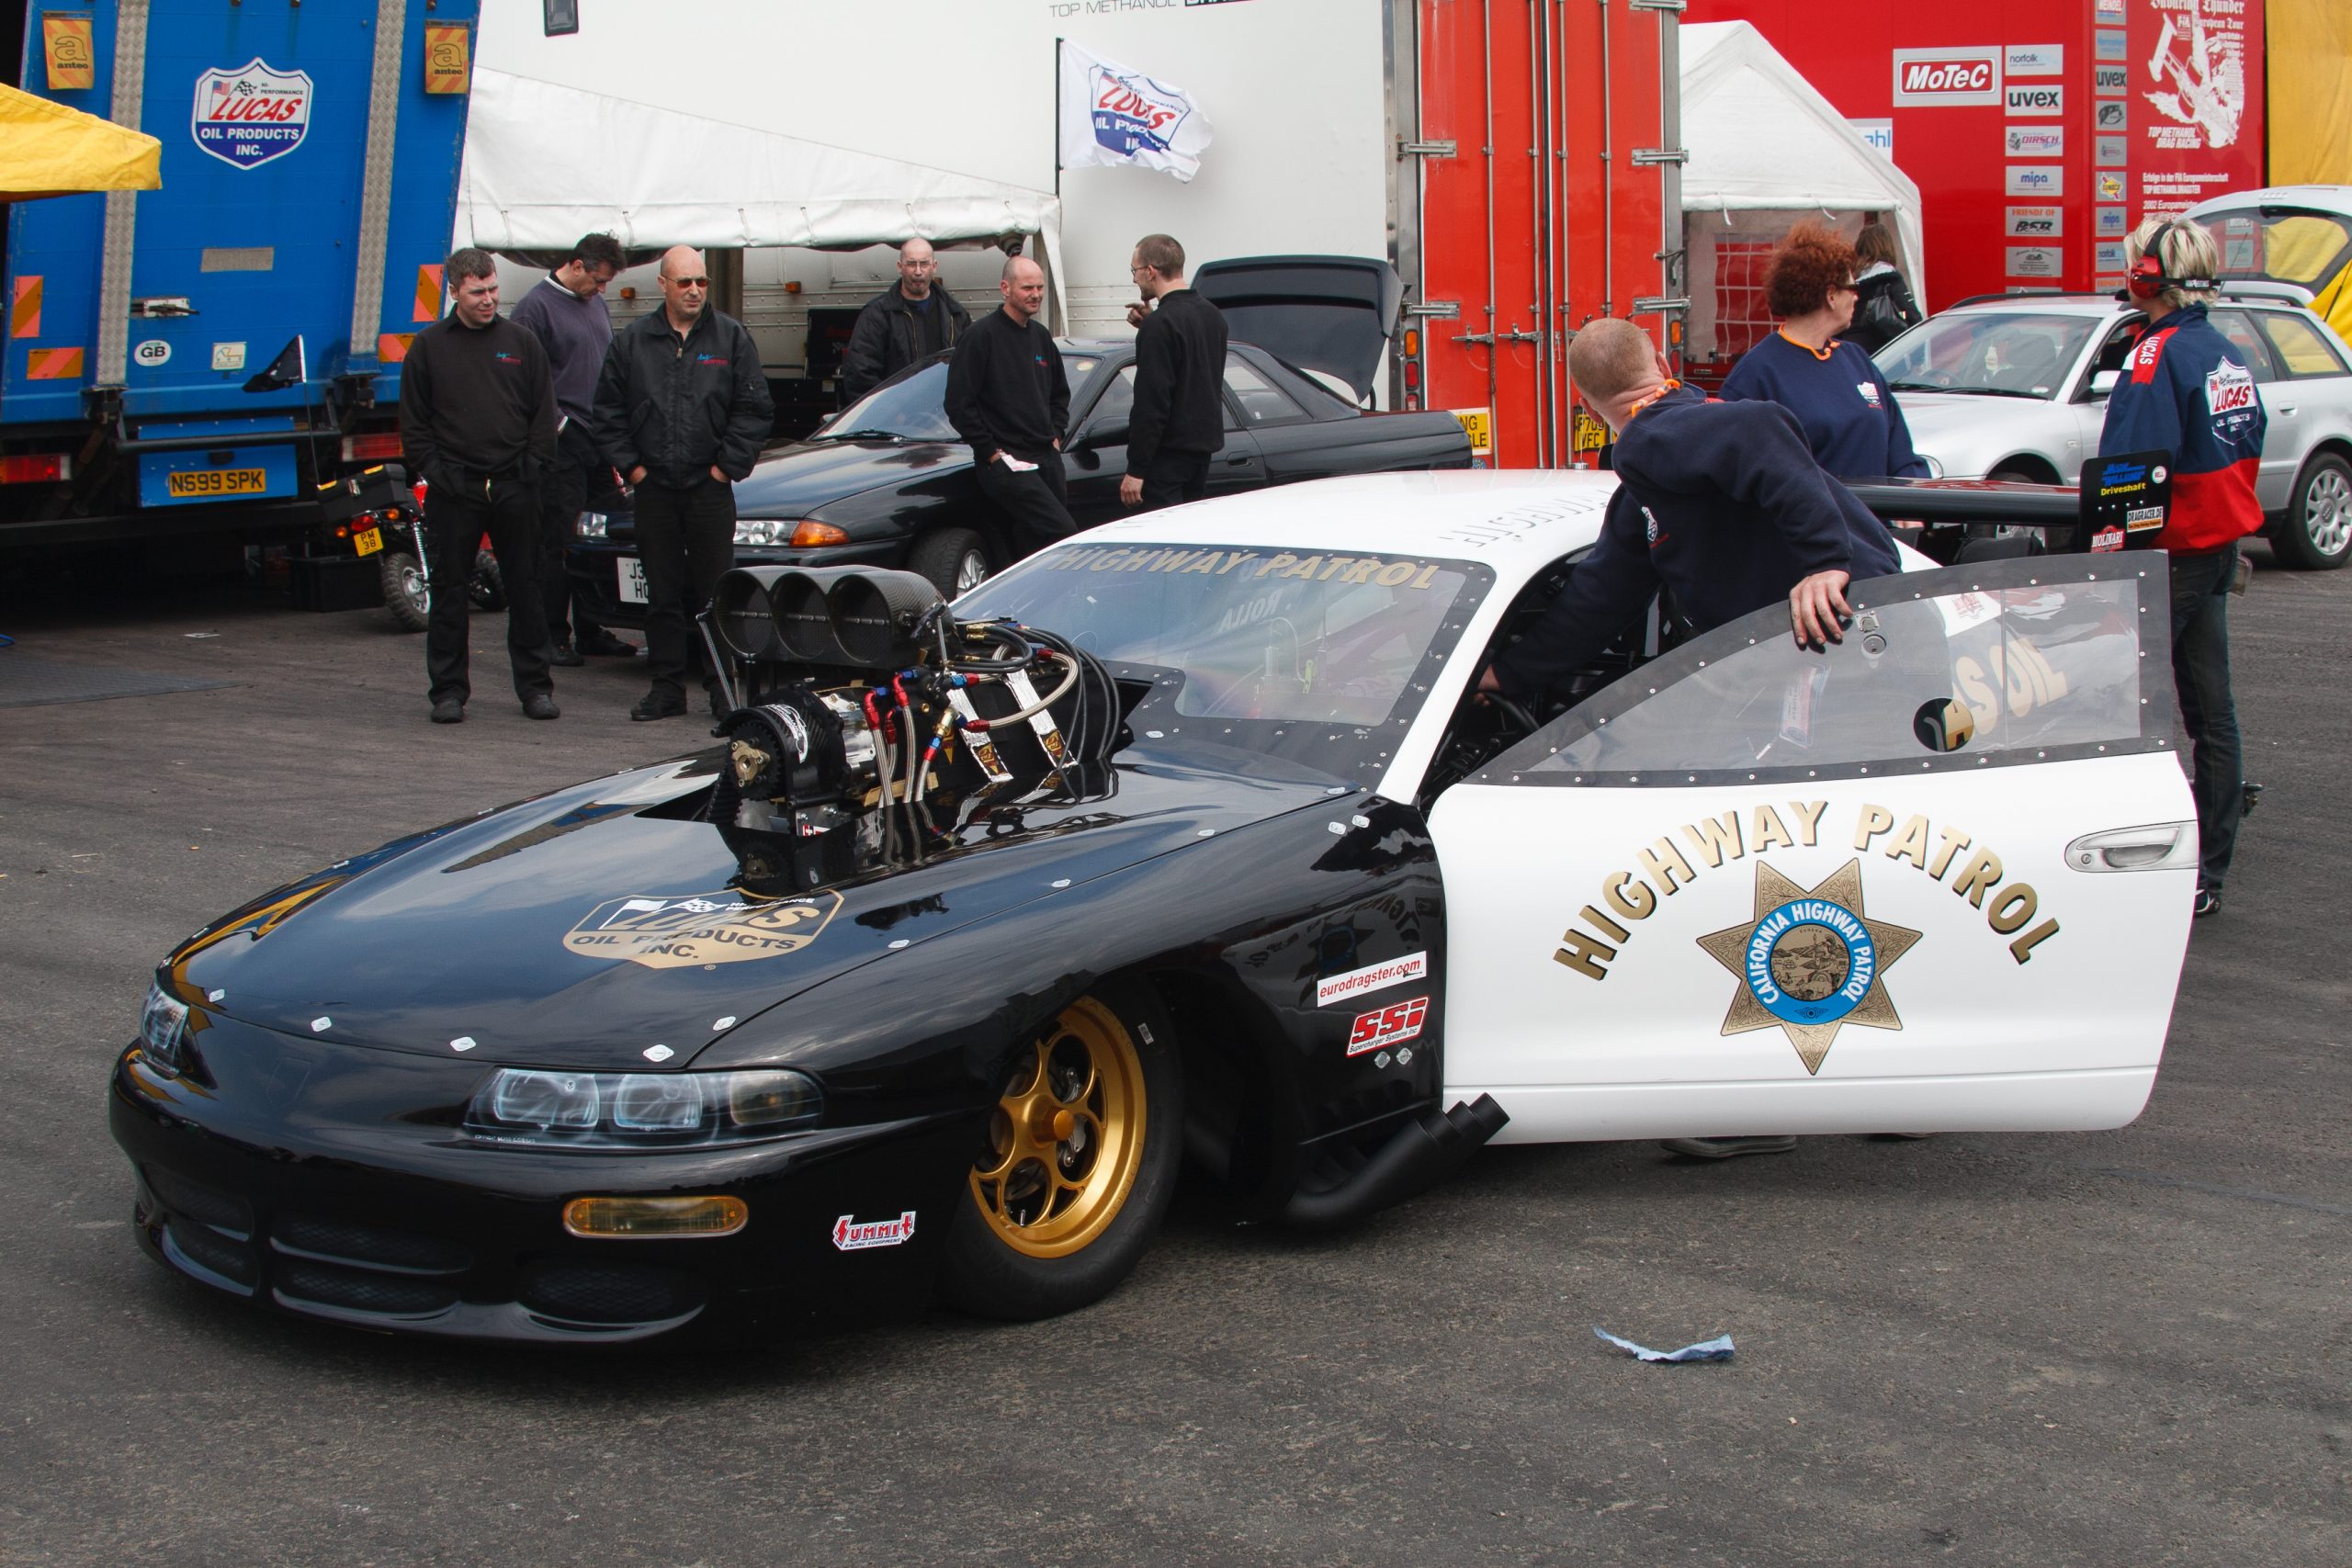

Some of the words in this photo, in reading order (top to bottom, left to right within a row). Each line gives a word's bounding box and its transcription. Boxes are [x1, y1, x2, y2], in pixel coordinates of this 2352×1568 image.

[1049, 4, 1081, 17] TOP
[1086, 0, 1177, 15] METHANOL
[2177, 16, 2190, 28] FIA
[55, 36, 87, 61] a
[434, 43, 462, 67] a
[2009, 53, 2038, 63] norfolk
[1905, 63, 1988, 90] MoTeC
[2097, 71, 2126, 86] uvex
[2008, 91, 2059, 107] uvex
[209, 97, 302, 121] LUCAS
[200, 128, 223, 140] OIL
[227, 128, 300, 141] PRODUCTS
[2021, 135, 2060, 145] DIRSCH
[2148, 127, 2161, 138] TOP
[236, 144, 264, 156] INC.
[2156, 138, 2176, 149] DRAG
[2020, 171, 2048, 187] mipa
[141, 346, 165, 358] GB
[2139, 336, 2161, 366] LUCAS
[2214, 385, 2251, 412] LUCAS
[226, 470, 263, 491] SPK
[2100, 482, 2146, 497] Driveshaft
[1046, 547, 1259, 575] HIGHWAY
[1254, 554, 1441, 590] PATROL
[1553, 800, 1828, 981] HIGHWAY
[1853, 803, 2061, 966] PATROL
[572, 935, 619, 946] OIL
[639, 942, 700, 959] INC.
[1749, 911, 1791, 1004] CALIFORNIA
[1791, 902, 1865, 942] HIGHWAY
[1841, 945, 1871, 1003] PATROL
[1319, 959, 1420, 998] eurodragster.com
[1349, 1037, 1385, 1053] Supercharger
[1385, 1031, 1408, 1043] Systems
